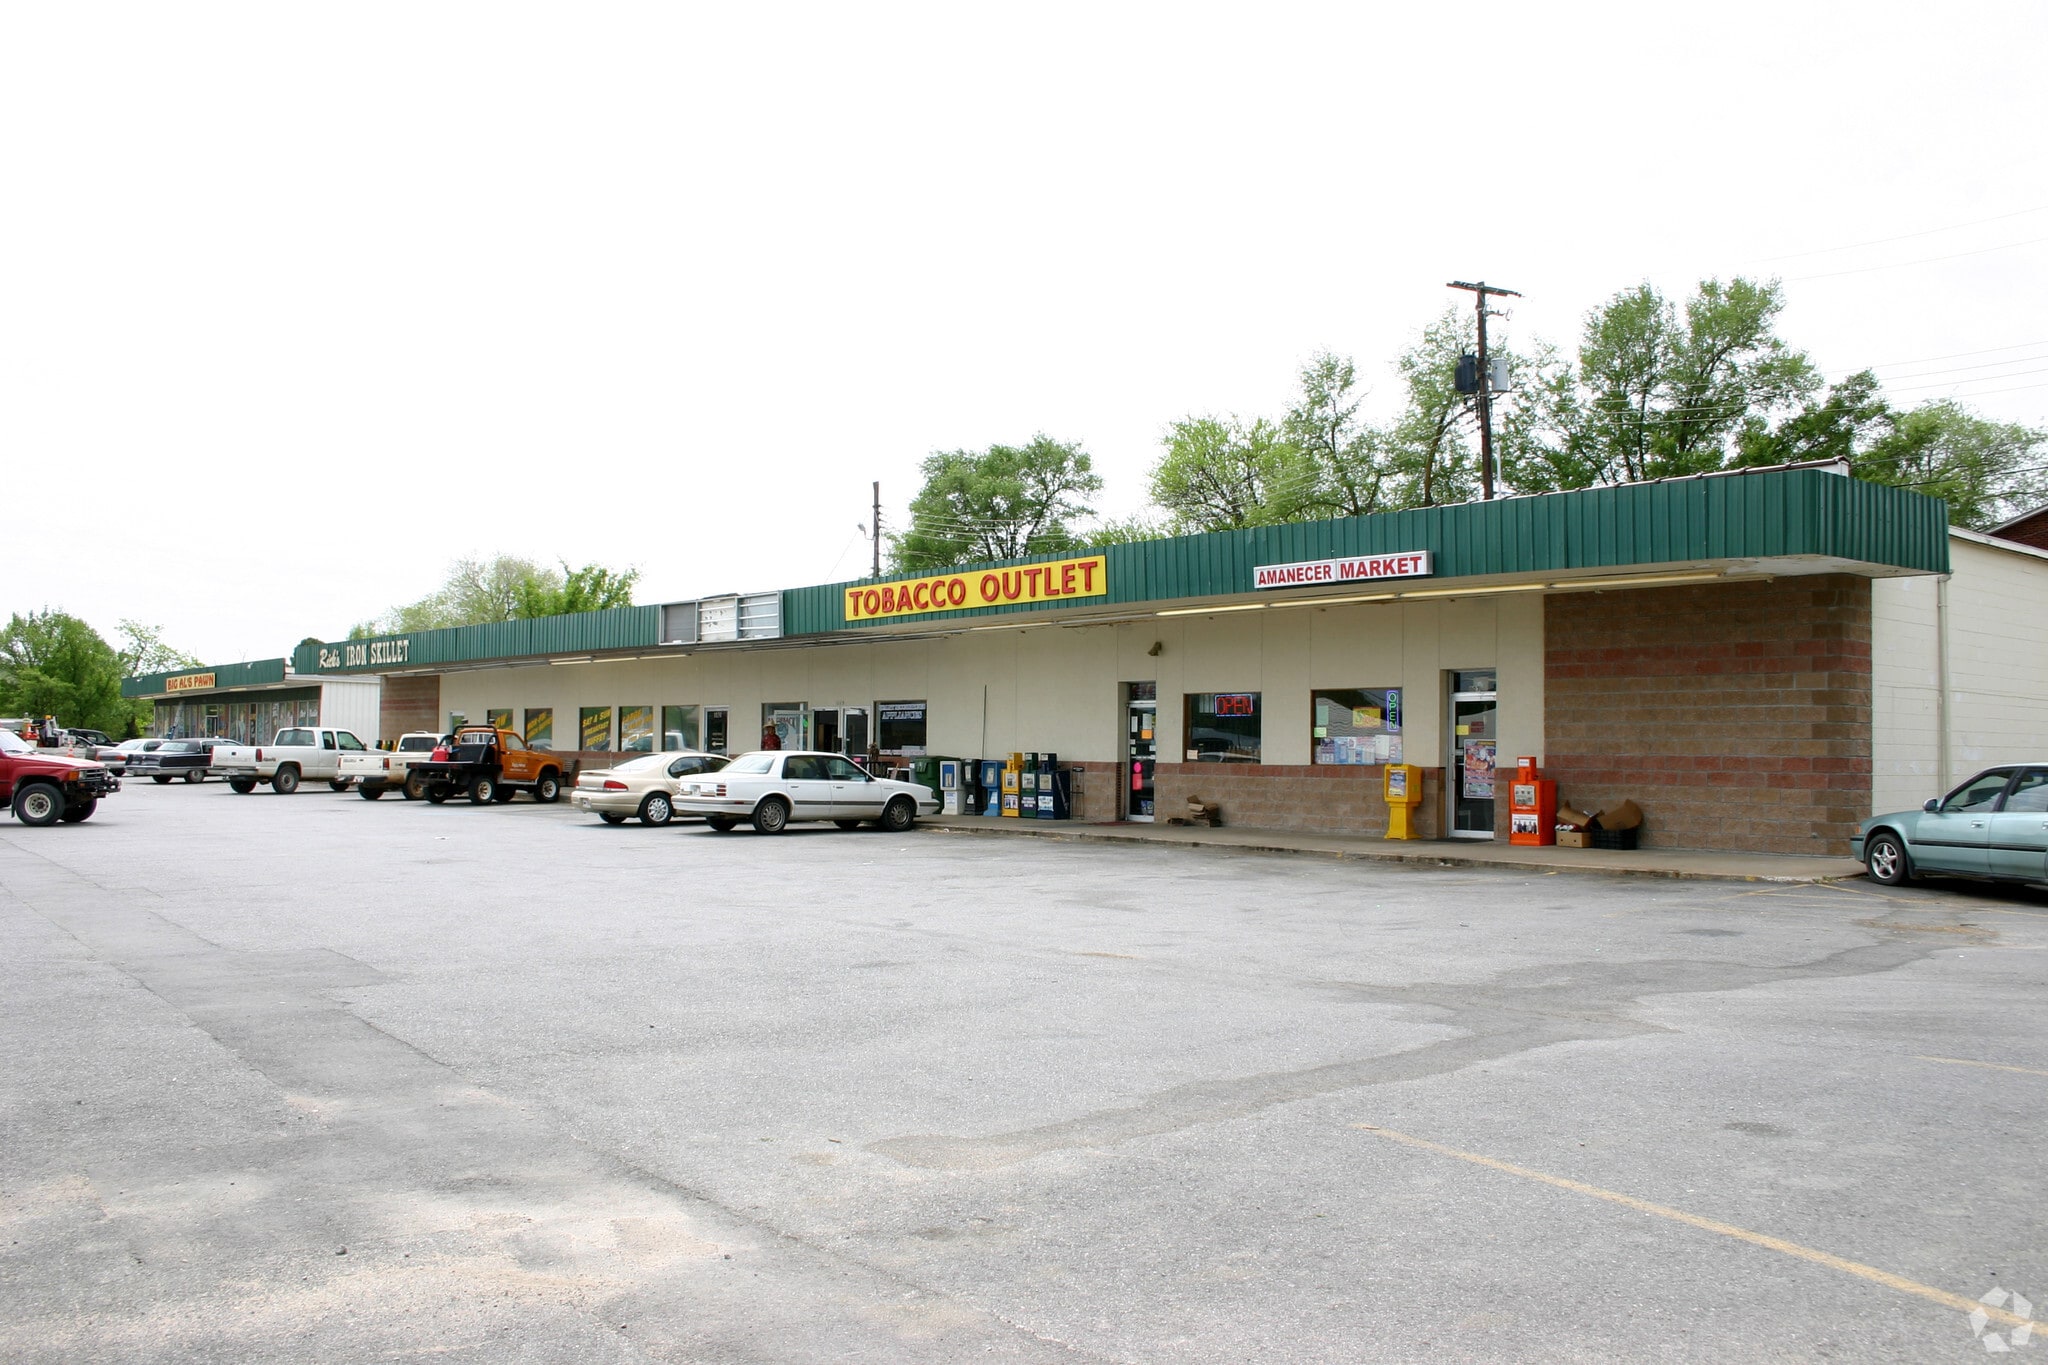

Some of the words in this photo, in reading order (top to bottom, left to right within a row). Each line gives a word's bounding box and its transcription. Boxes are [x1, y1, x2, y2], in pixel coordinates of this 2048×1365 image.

[1257, 564, 1332, 586] AMANECER
[1340, 556, 1423, 579] MARKET
[849, 578, 967, 616] TOBACCO
[980, 561, 1098, 602] OUTLET
[319, 648, 341, 668] Rick's
[346, 644, 368, 666] IRON
[371, 639, 409, 664] SKILLET
[167, 679, 178, 690] BIG
[194, 674, 214, 687] PAWN
[1216, 696, 1253, 715] OPEN
[1388, 692, 1398, 730] OPEN
